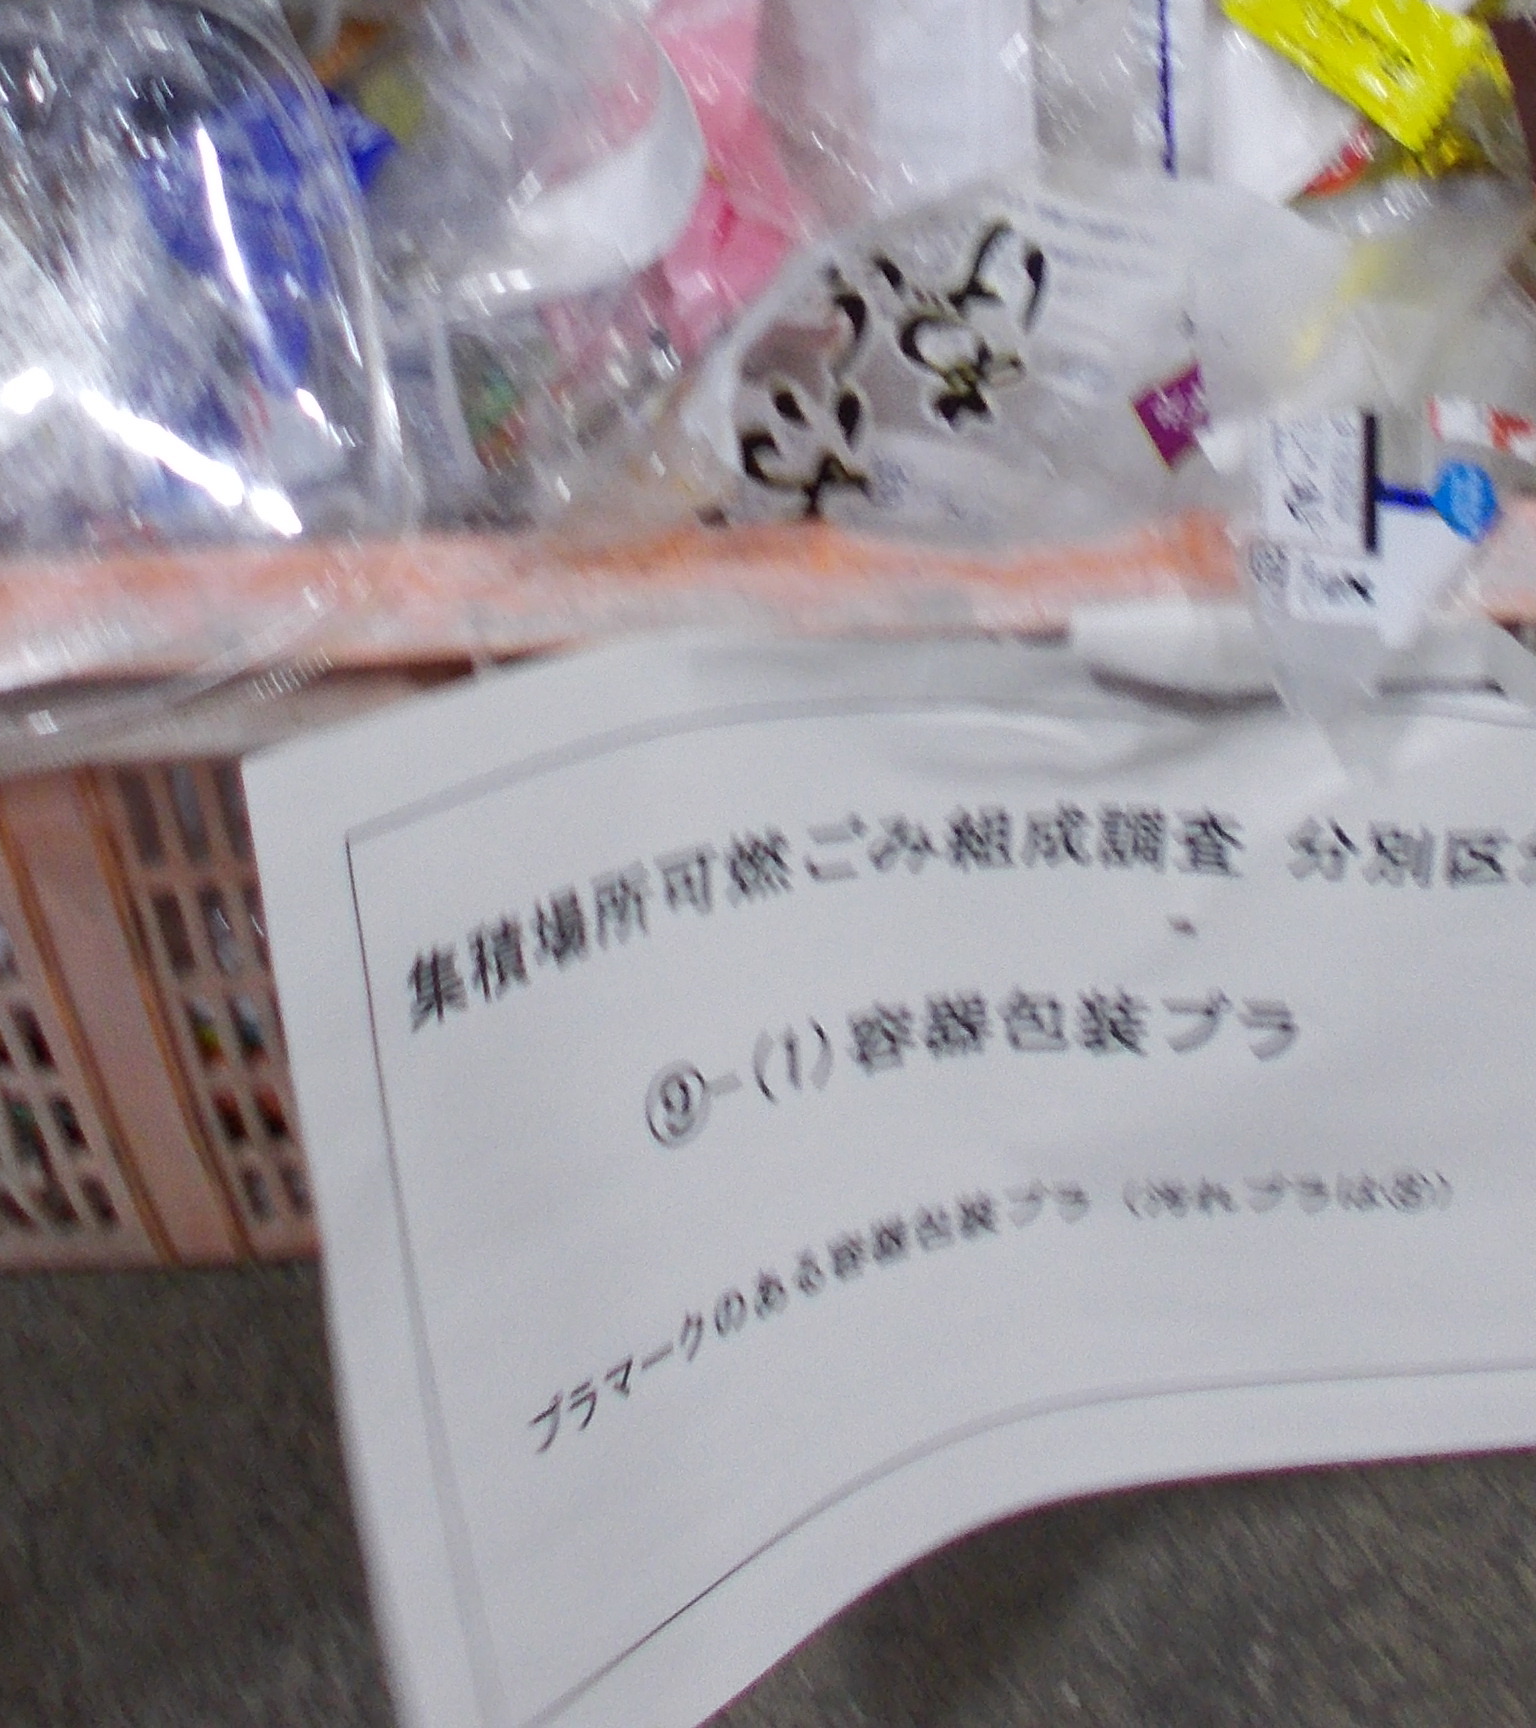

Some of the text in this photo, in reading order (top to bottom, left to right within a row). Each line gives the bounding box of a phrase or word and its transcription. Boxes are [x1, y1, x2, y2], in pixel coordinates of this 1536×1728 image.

[406, 802, 1246, 1036] 集積場所可燃ごみ組成調査
